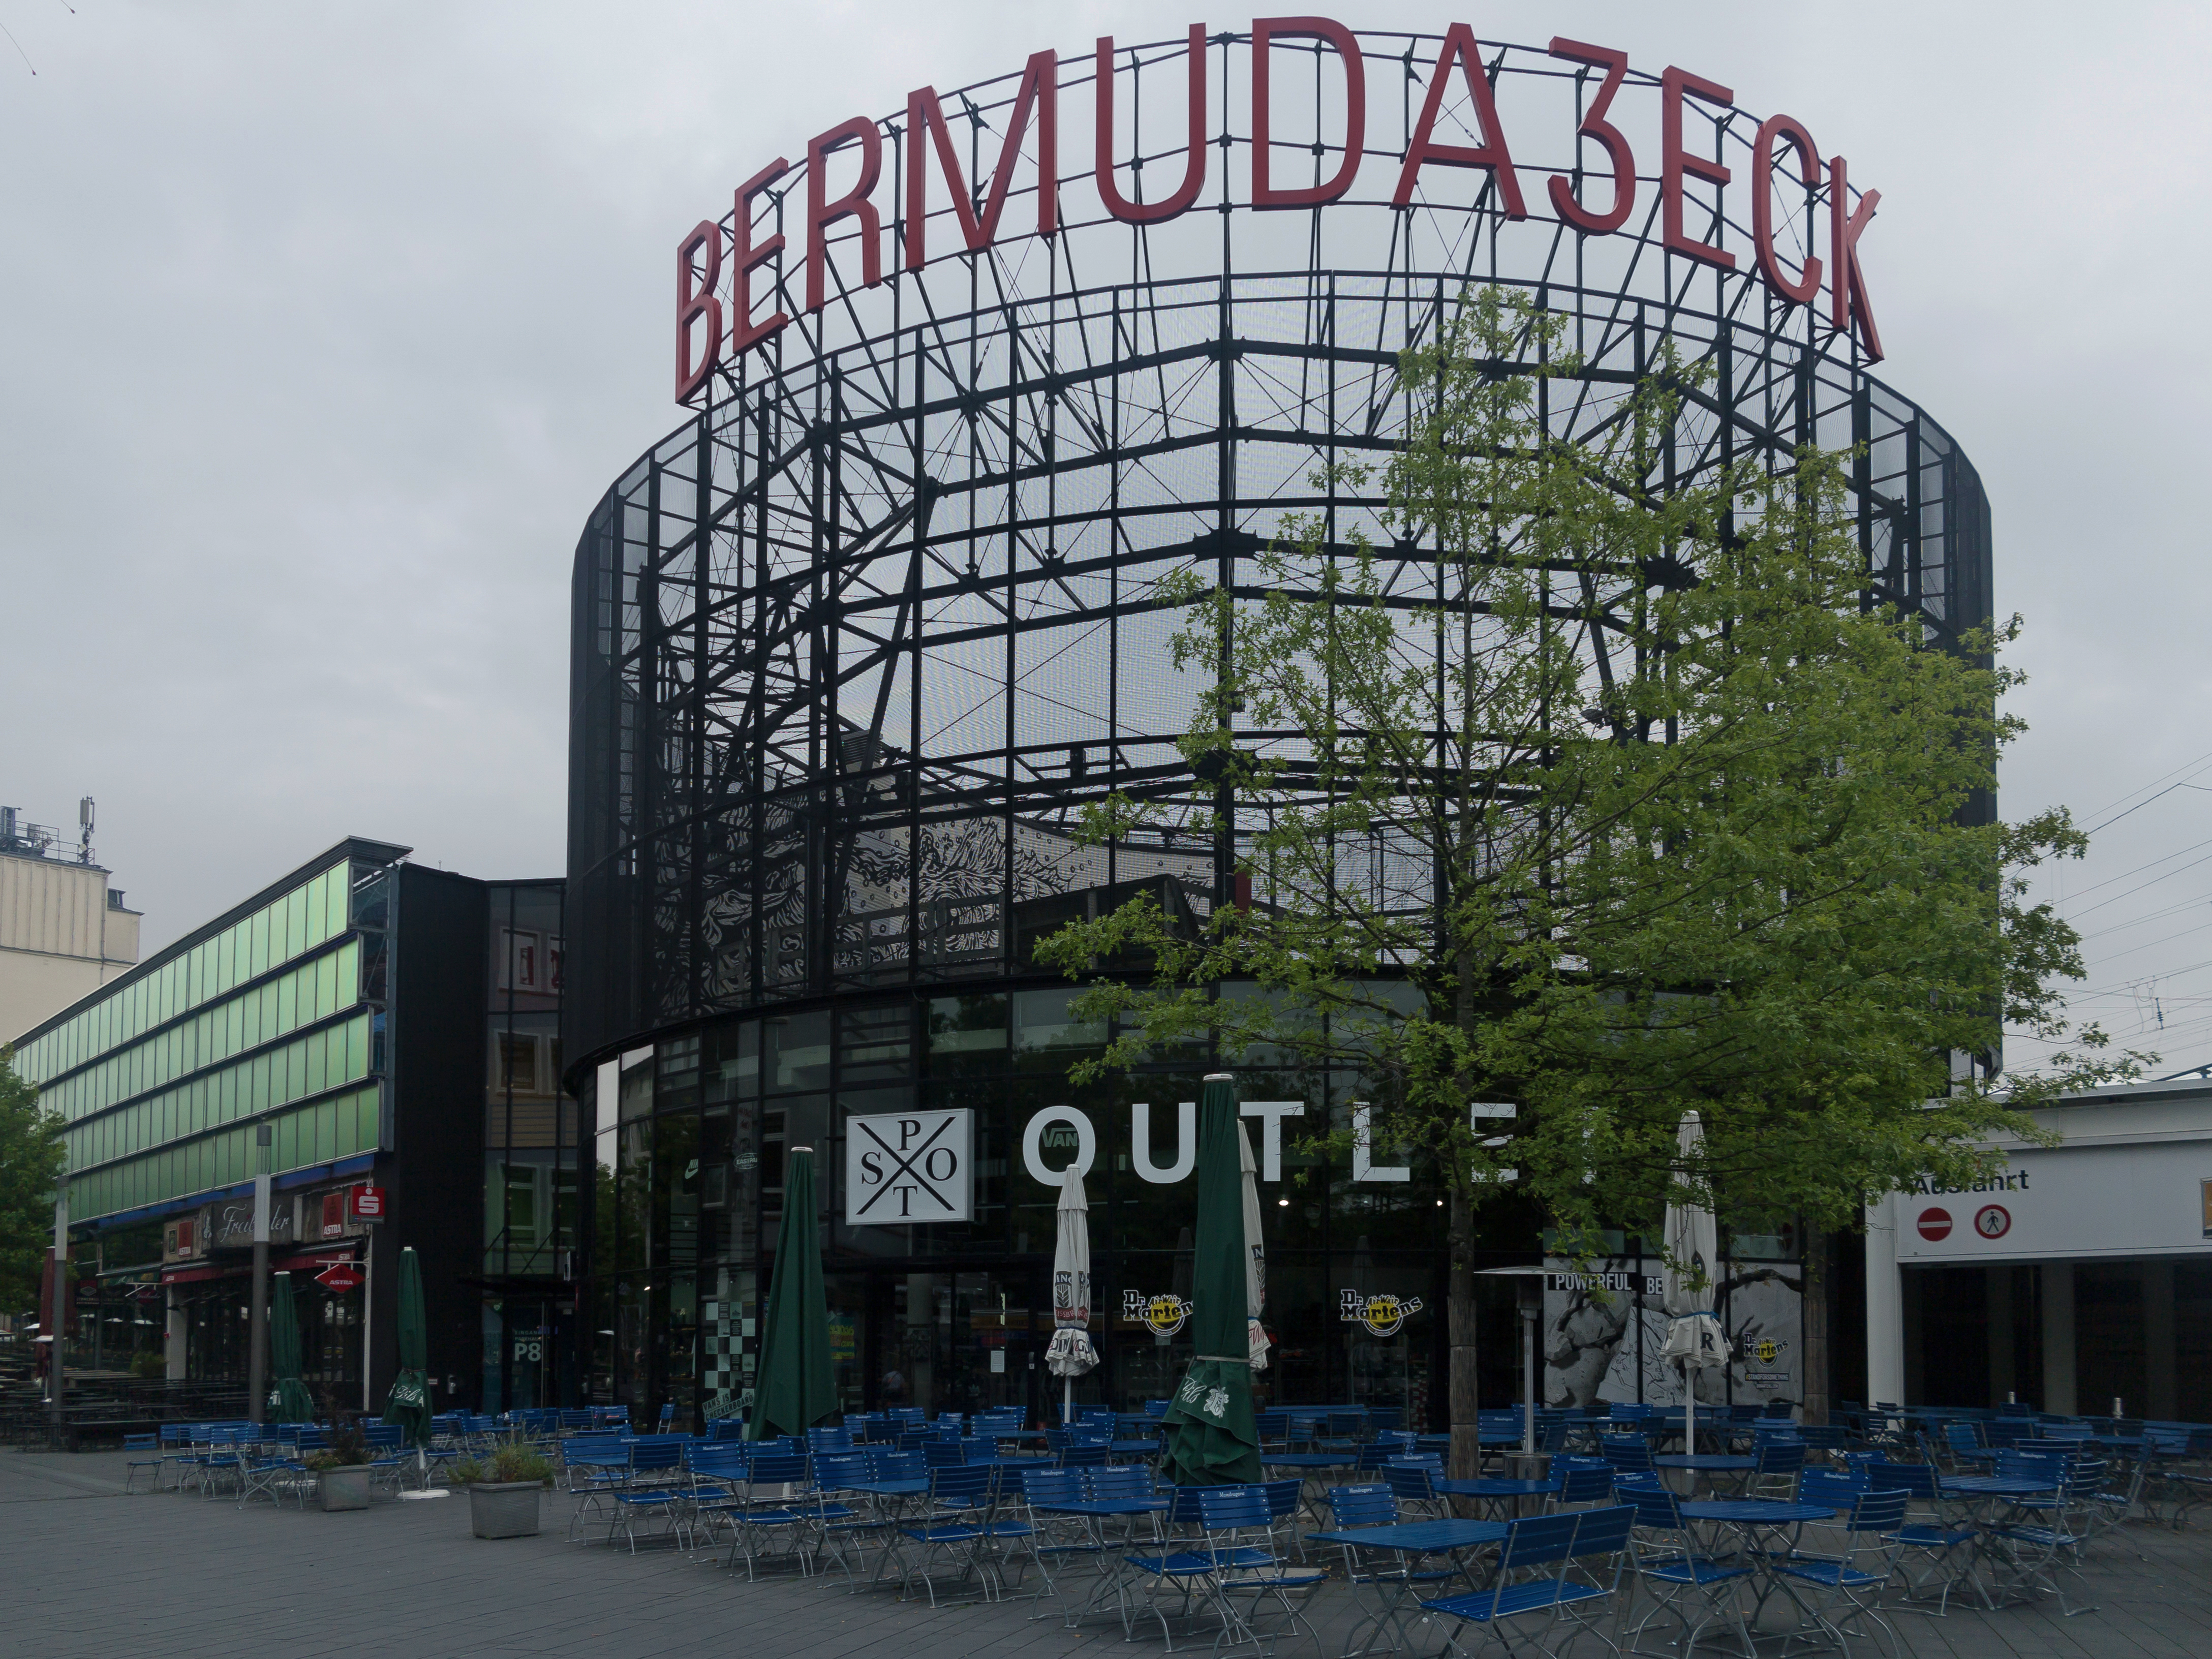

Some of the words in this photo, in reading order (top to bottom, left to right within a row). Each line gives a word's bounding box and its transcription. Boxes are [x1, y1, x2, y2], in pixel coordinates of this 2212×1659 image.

[675, 16, 1884, 405] BERMUDA3ECK
[1023, 1101, 1617, 1187] OUTLE
[1042, 1127, 1079, 1147] VAN
[323, 1224, 342, 1235] ASTRA
[1555, 1273, 1632, 1291] POWERFUL
[1123, 1300, 1193, 1320] Marten
[1341, 1297, 1423, 1320] Martens
[514, 1343, 541, 1362] P8
[1744, 1339, 1789, 1357] Martens
[703, 1397, 721, 1411] VANS
[722, 1393, 729, 1403] IS
[705, 1394, 753, 1422] CHECKERBOARD
